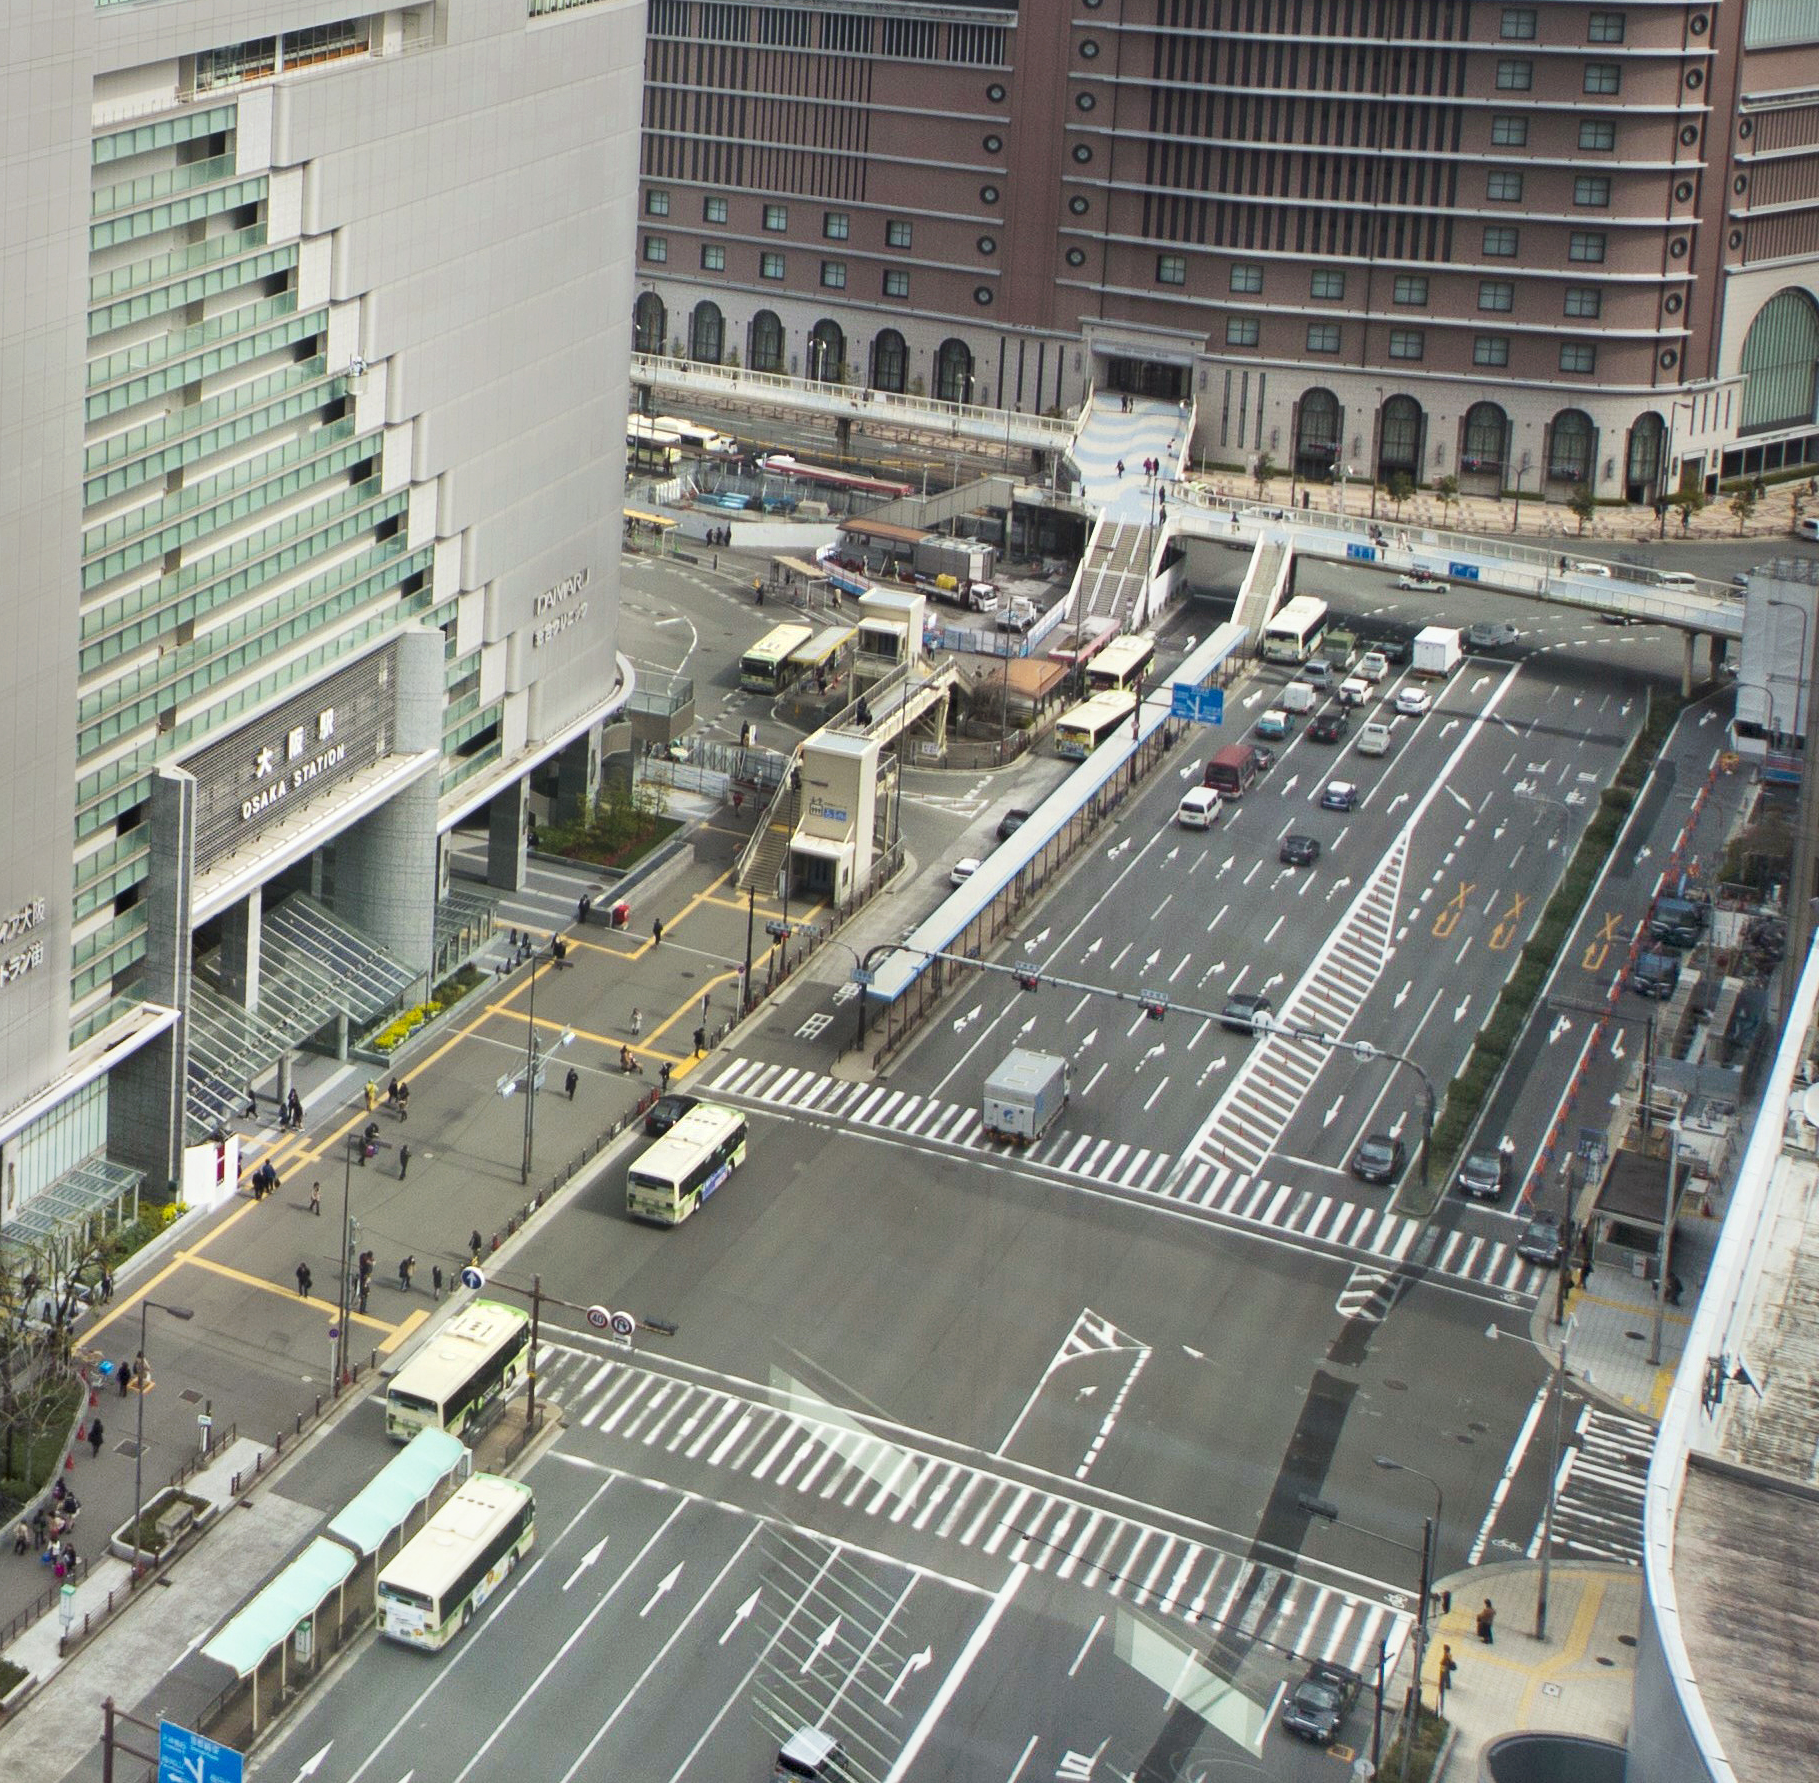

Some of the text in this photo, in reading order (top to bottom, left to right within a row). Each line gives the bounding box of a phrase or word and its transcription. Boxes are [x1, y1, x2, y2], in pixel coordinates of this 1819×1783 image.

[256, 708, 334, 778] 大阪駅
[242, 743, 346, 819] OSAKA STATION
[592, 1313, 605, 1326] 40
